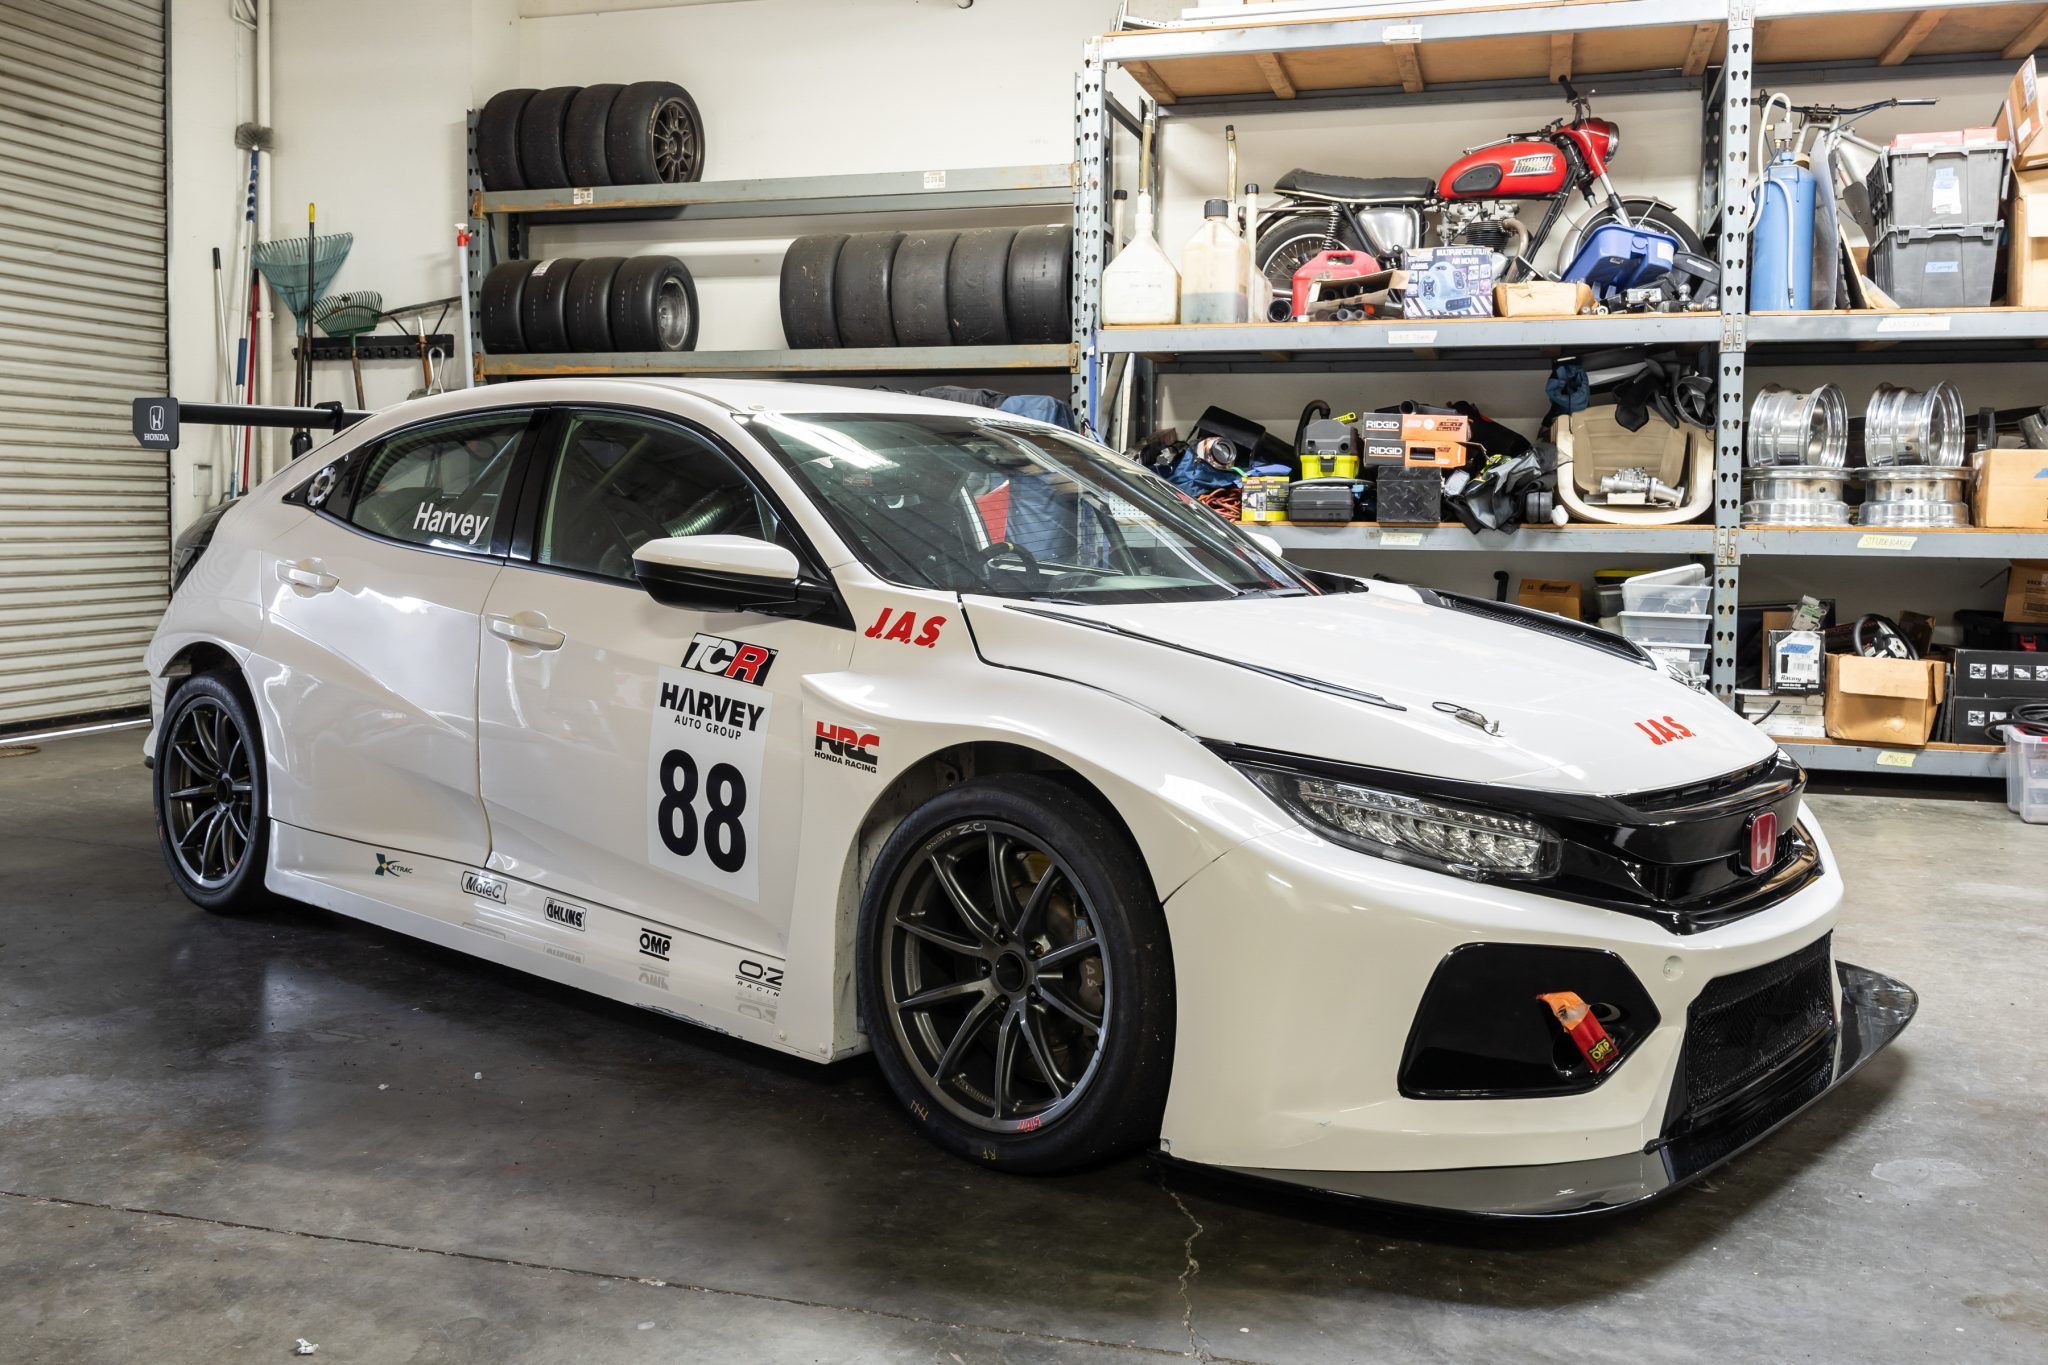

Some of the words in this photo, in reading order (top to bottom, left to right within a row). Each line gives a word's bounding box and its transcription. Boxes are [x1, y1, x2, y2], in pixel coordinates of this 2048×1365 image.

[143, 433, 170, 441] HONDA
[1366, 420, 1399, 429] RIDGID
[1368, 446, 1402, 455] RIDGID
[412, 501, 490, 545] Harvey
[864, 607, 947, 649] J.A.S.
[685, 632, 769, 684] TCR
[659, 682, 766, 732] HARVEY
[674, 714, 702, 730] AUTO
[705, 722, 742, 740] GROUP
[1634, 715, 1697, 746] J.A.S.
[814, 720, 881, 766] HRC
[814, 750, 843, 765] HONDA
[844, 759, 877, 774] RACING
[657, 748, 747, 873] 88
[390, 863, 413, 875] XTRAC
[465, 876, 503, 899] MoTeC
[546, 899, 584, 928] ÖHLINS
[639, 933, 671, 956] OMP
[1591, 1041, 1611, 1060] OMP
